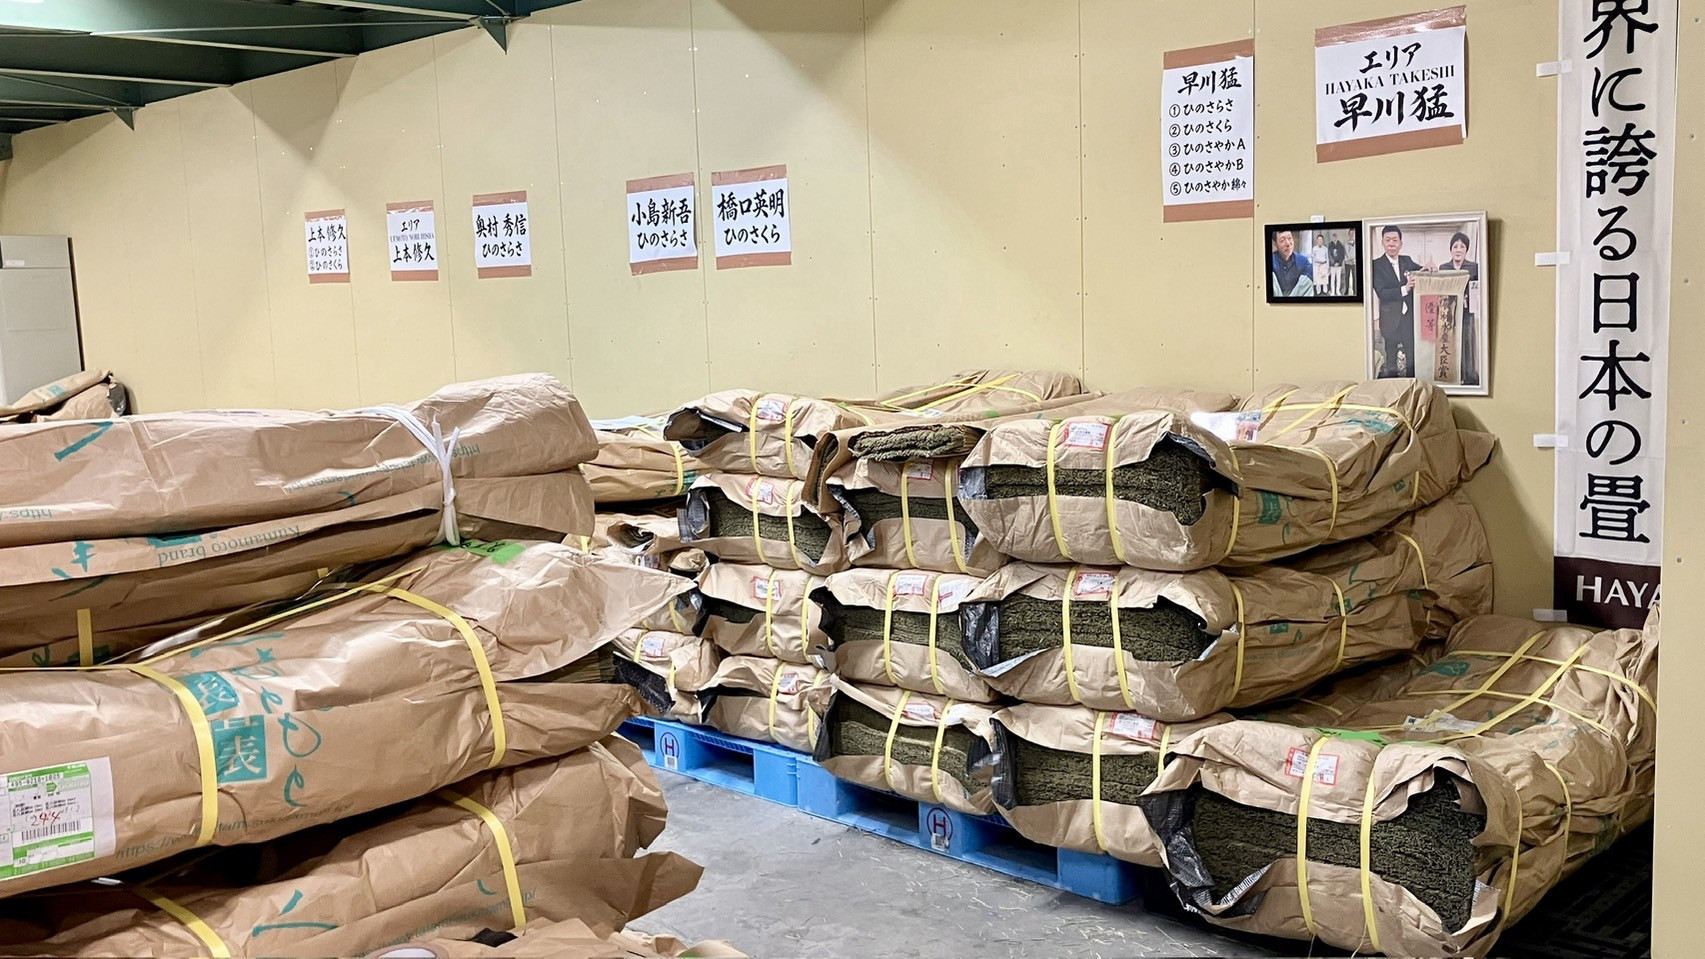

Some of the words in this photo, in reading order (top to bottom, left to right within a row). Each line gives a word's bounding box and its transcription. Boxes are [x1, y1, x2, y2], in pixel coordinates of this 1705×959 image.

[1359, 42, 1422, 73] エリア
[1177, 66, 1242, 95] 早川猛
[1325, 75, 1385, 95] HAYAKA
[1390, 65, 1455, 86] TAKESHI
[1333, 83, 1455, 132] 早川猛
[631, 198, 692, 227] 小島新吾
[717, 188, 785, 221] 橋口英明
[401, 219, 420, 232] エリア
[637, 229, 688, 249] ひのさらさ
[724, 224, 781, 245] ひのさくら
[482, 241, 523, 258] ひのさらさ
[1579, 0, 1658, 543] 界に誇る日本の畳
[157, 545, 207, 567] brand
